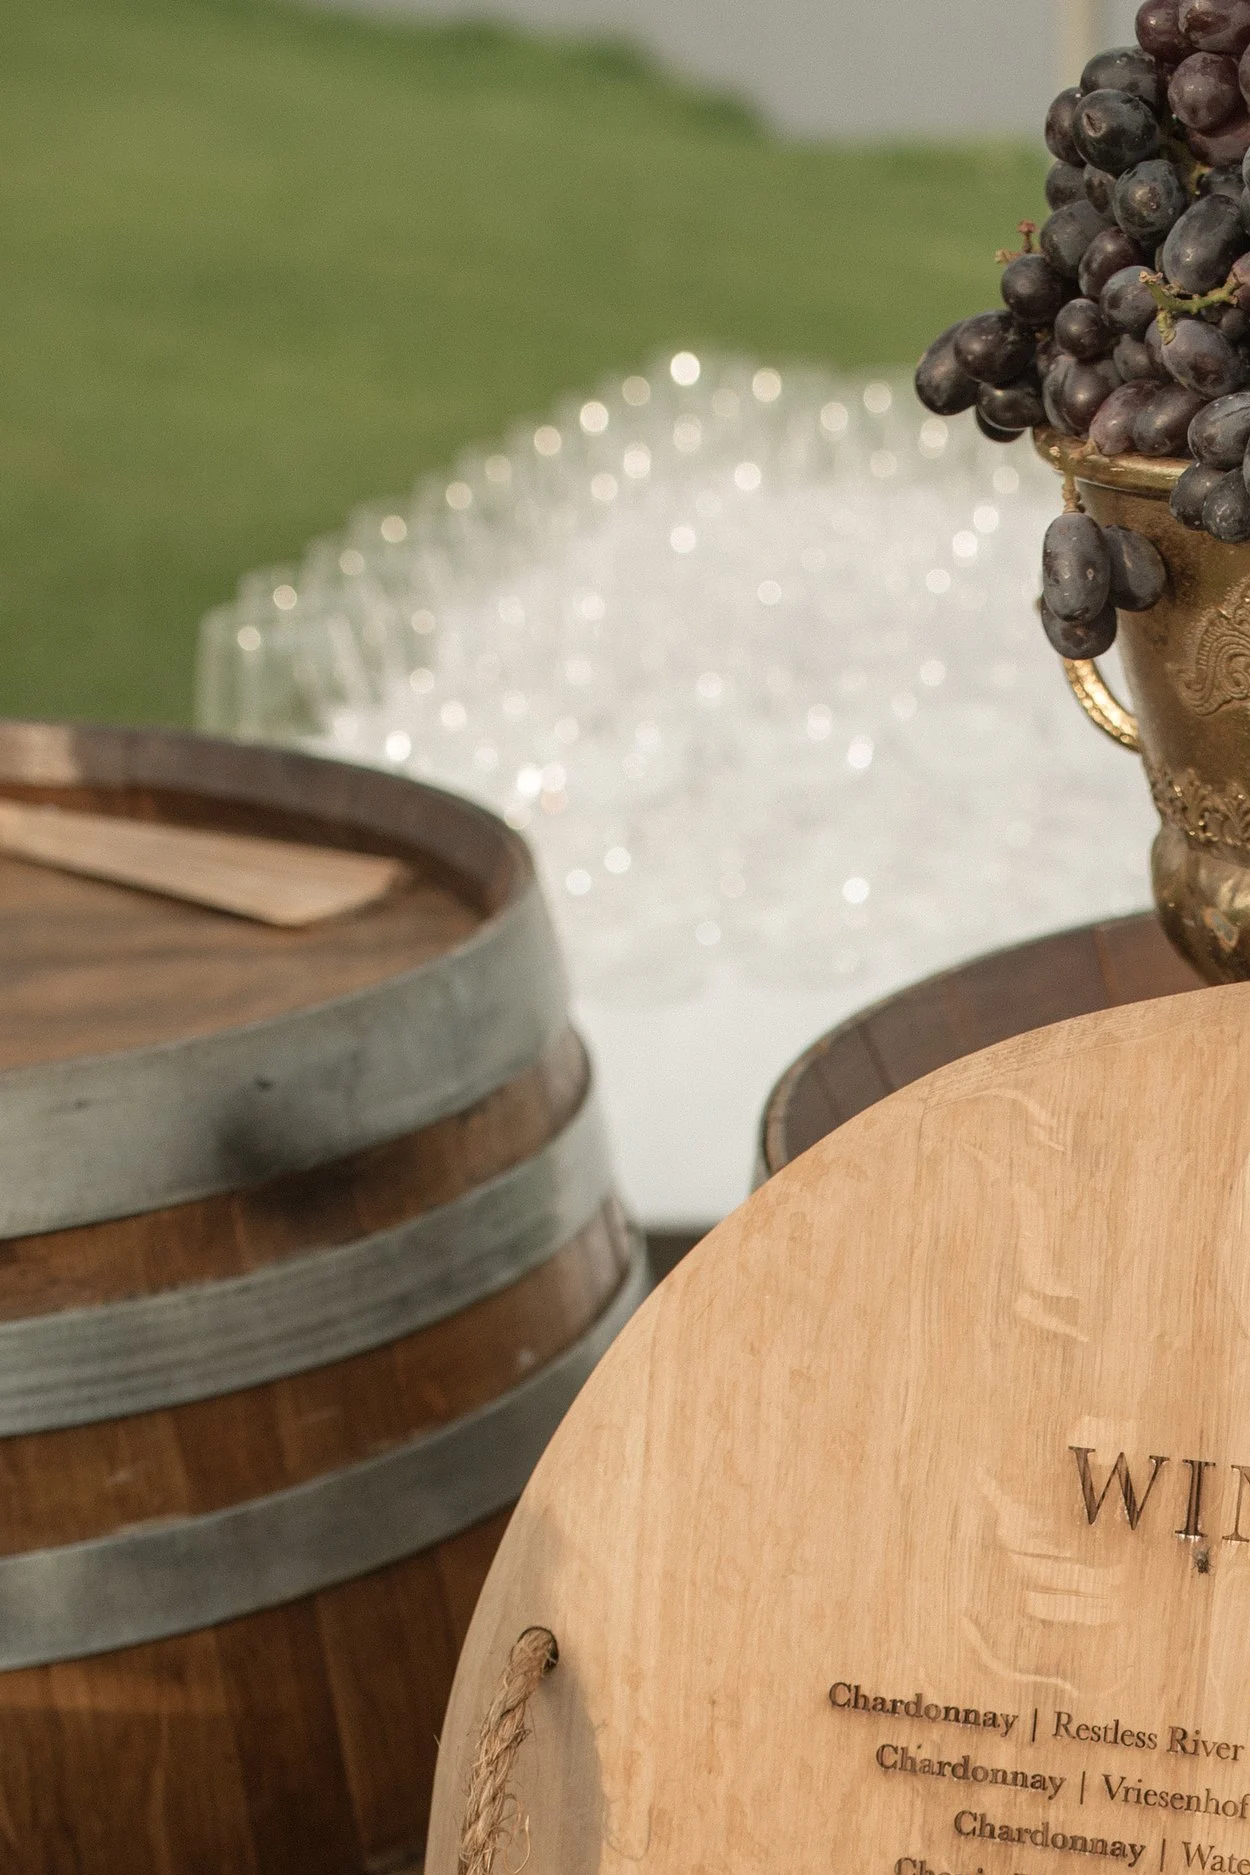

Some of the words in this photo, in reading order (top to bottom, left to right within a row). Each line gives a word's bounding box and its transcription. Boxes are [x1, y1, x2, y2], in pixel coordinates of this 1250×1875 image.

[829, 1682, 1018, 1735] Chardonnay
[1053, 1711, 1157, 1751] Restless
[1168, 1726, 1244, 1762] River
[876, 1744, 1065, 1798] Chardonnay
[955, 1811, 1145, 1866] Chardonnay
